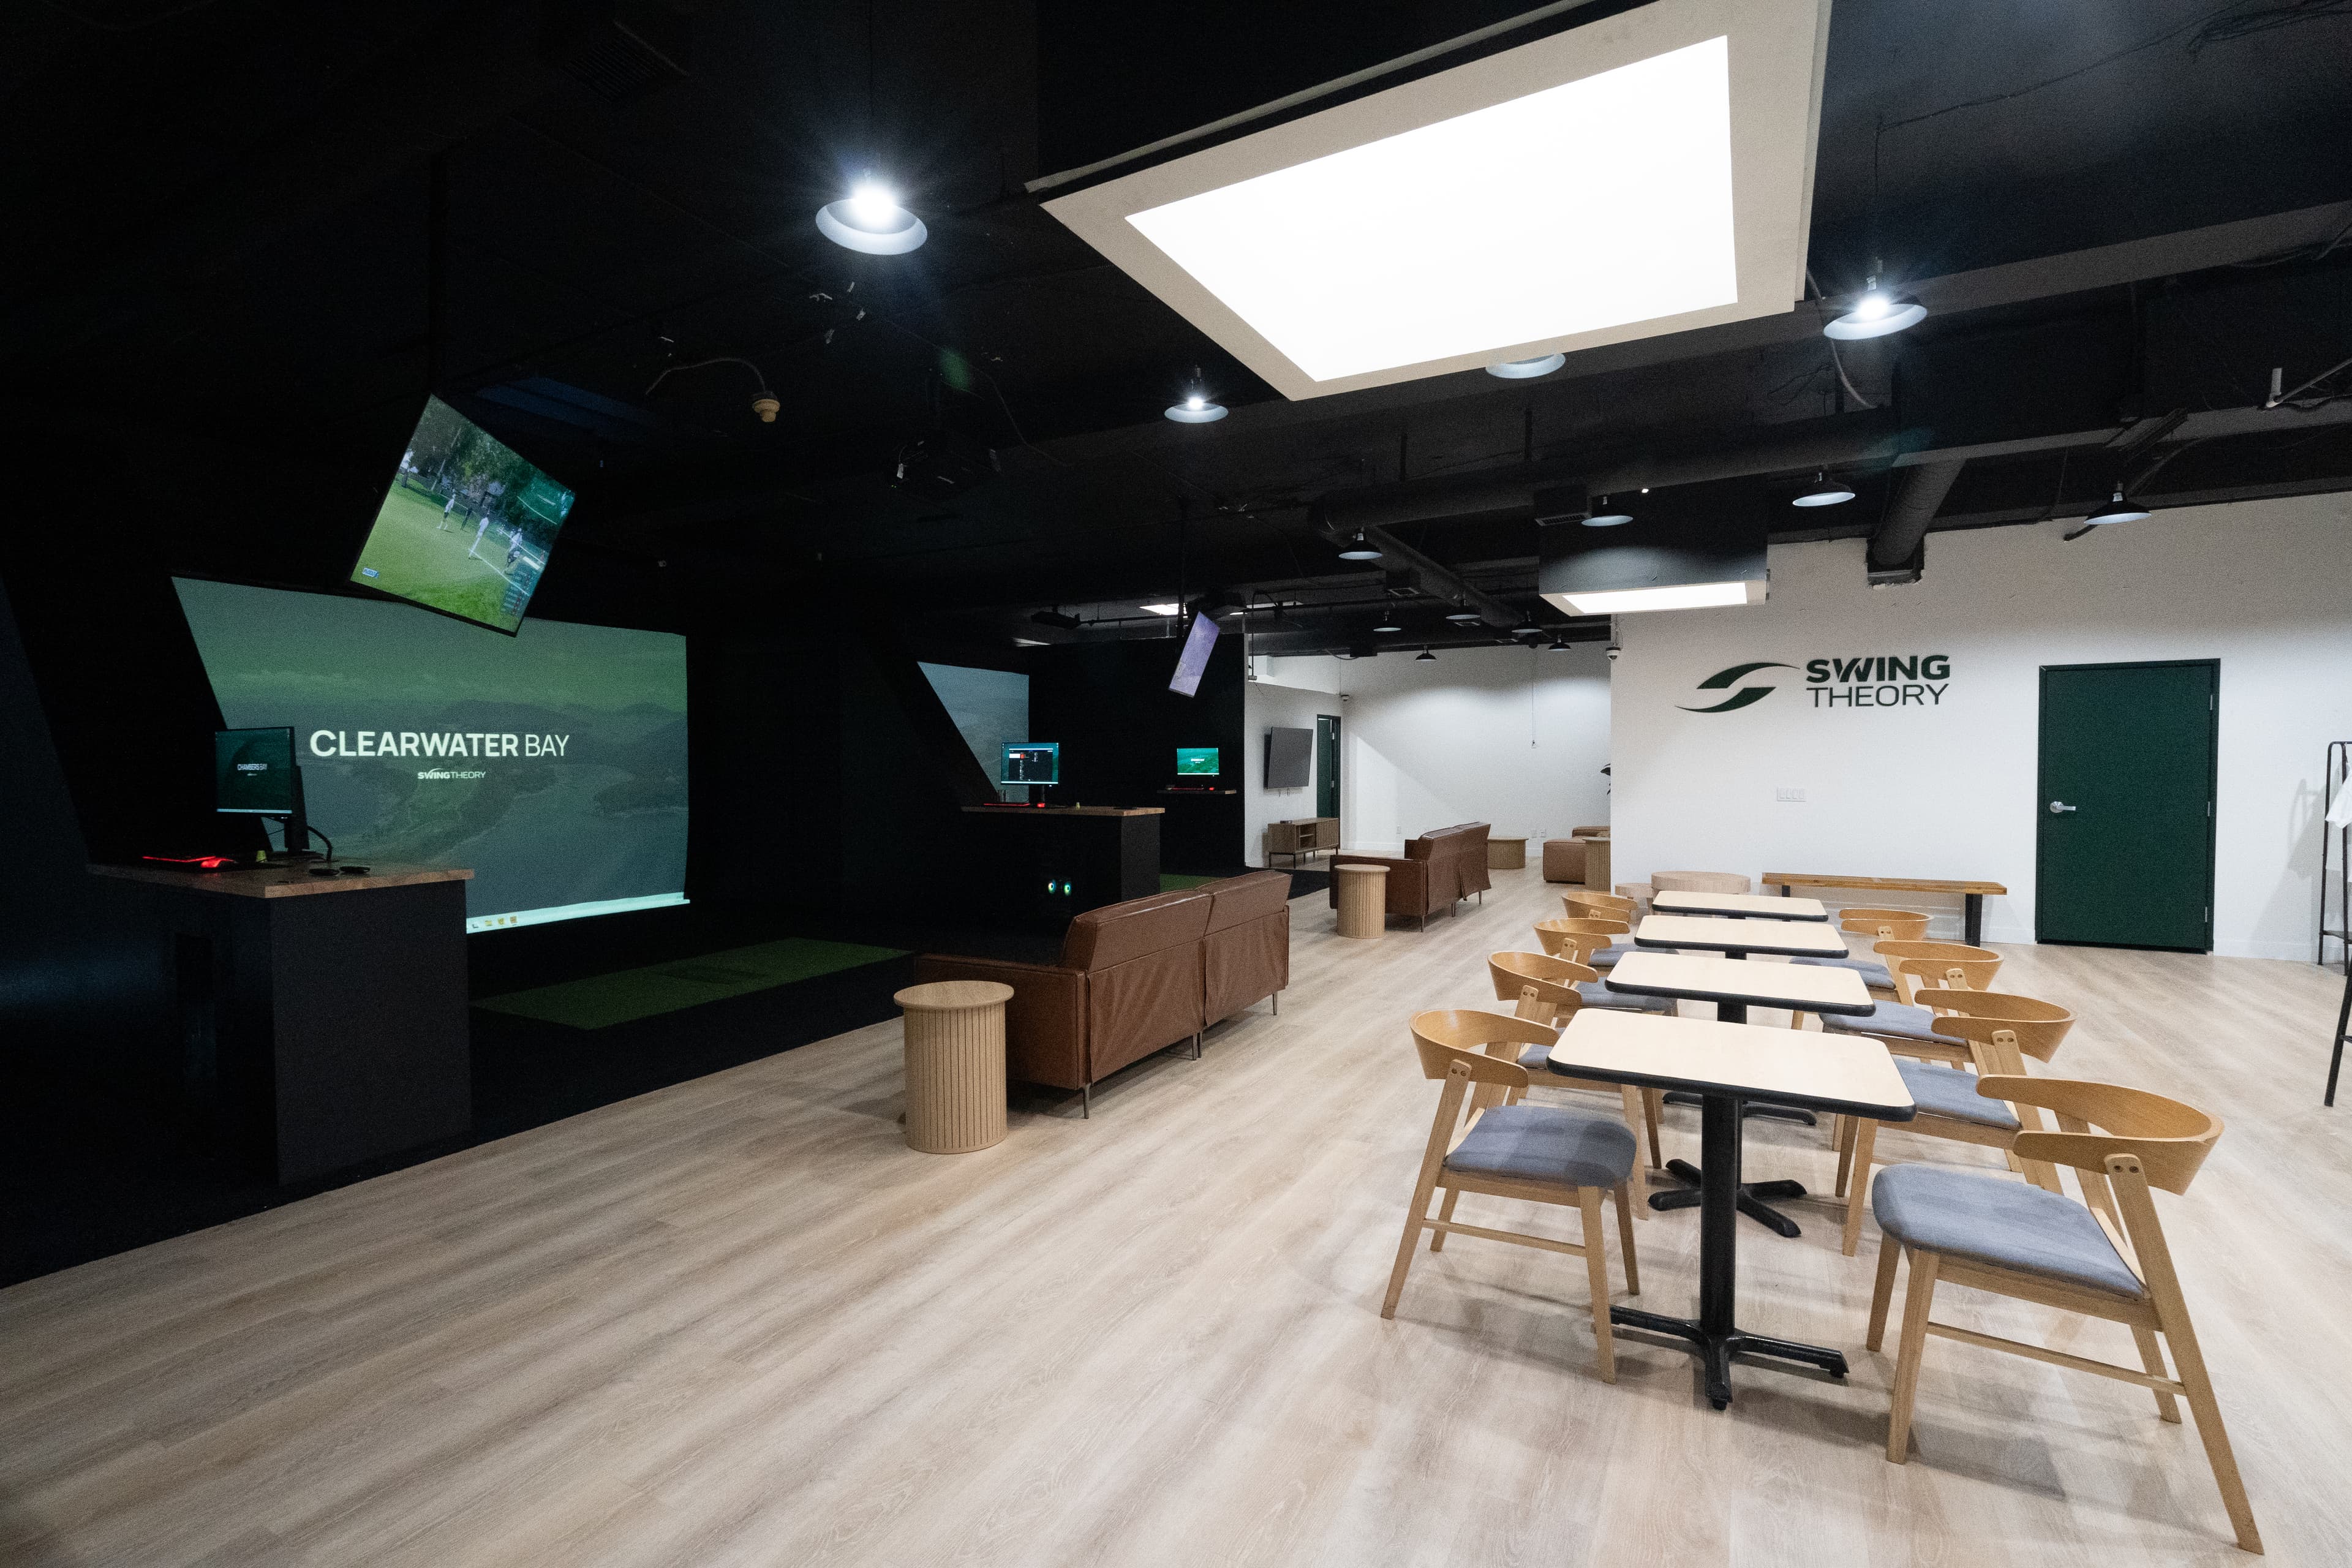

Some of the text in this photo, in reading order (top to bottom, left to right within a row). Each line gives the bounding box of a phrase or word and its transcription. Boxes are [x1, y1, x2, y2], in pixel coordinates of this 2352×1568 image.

[1806, 655, 1950, 683] SWING
[1806, 684, 1950, 707] THEORY
[310, 729, 570, 757] CLEARWATER BAY
